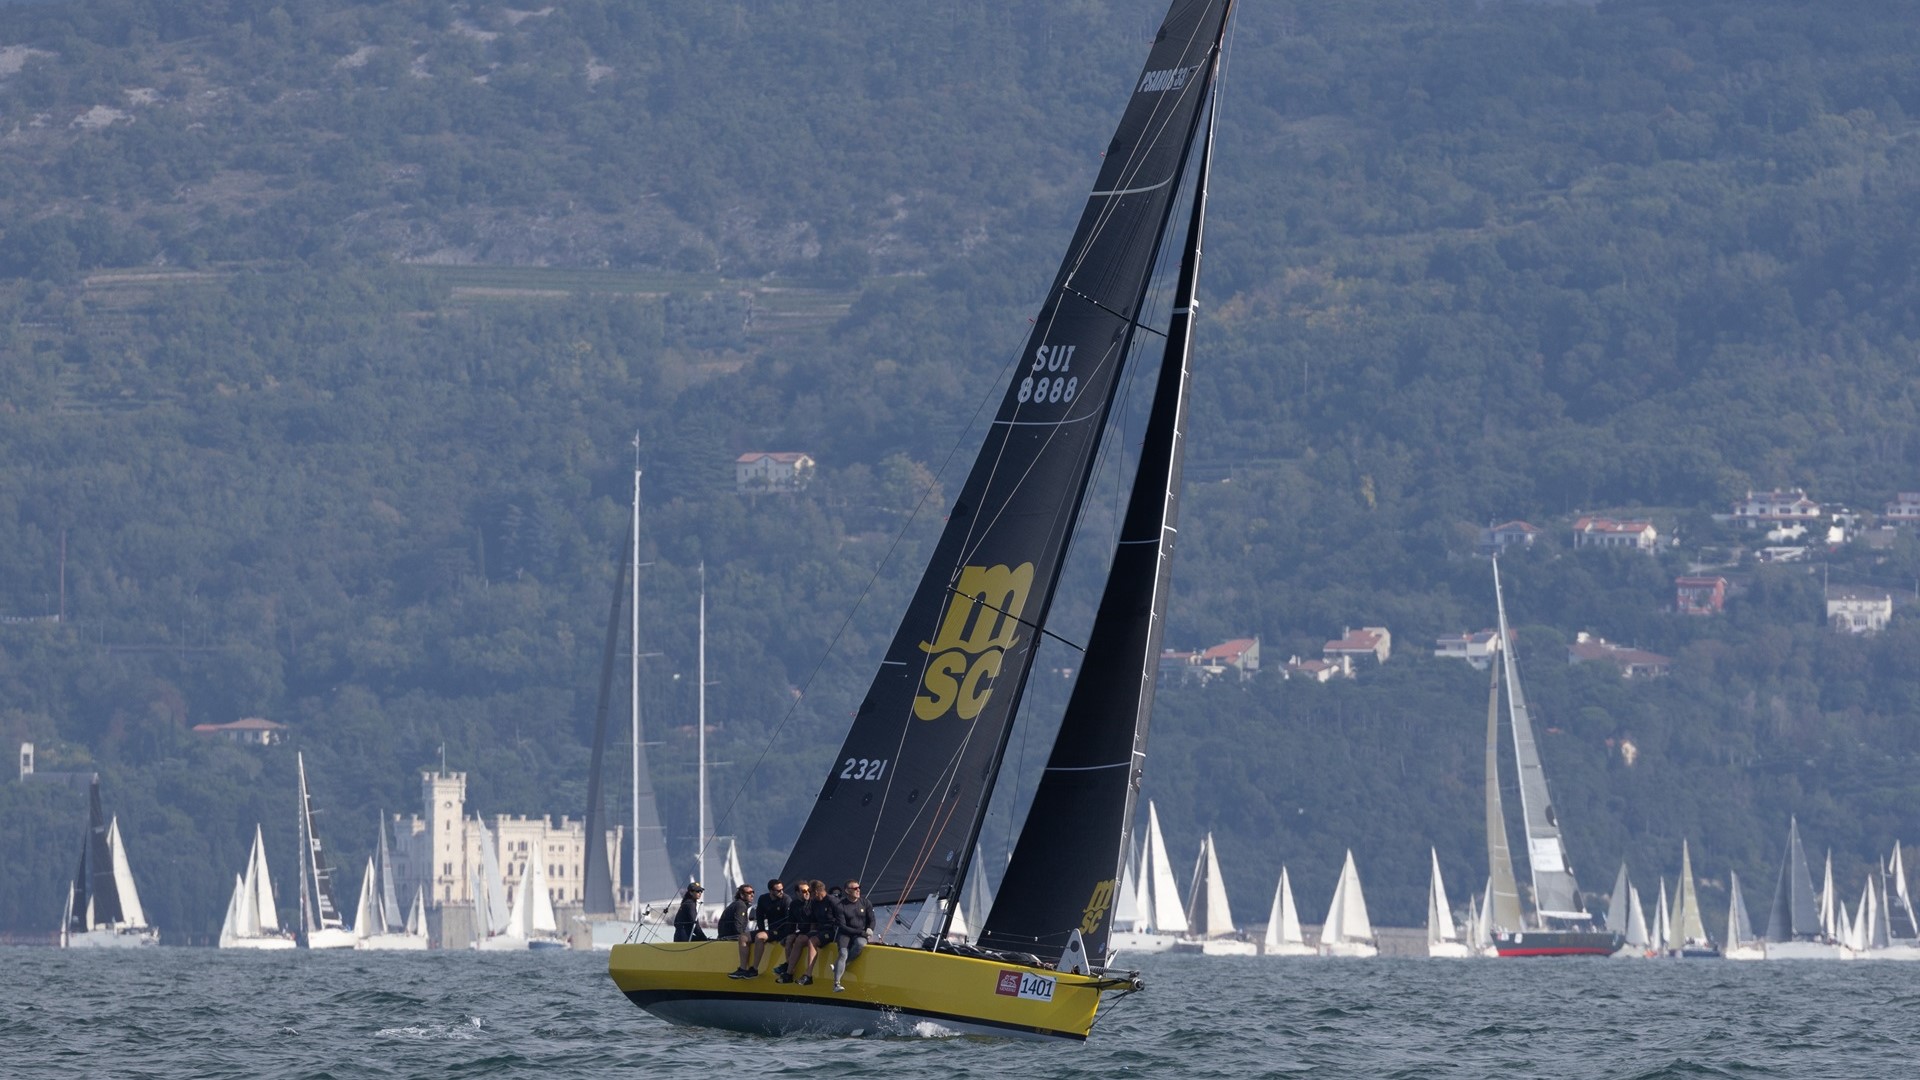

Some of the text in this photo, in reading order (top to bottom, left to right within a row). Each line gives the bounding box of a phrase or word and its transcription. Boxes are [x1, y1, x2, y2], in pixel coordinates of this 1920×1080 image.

[1032, 345, 1076, 372] SUI
[1018, 377, 1078, 403] 8888
[840, 758, 888, 780] 2321
[1021, 978, 1053, 997] 1401
